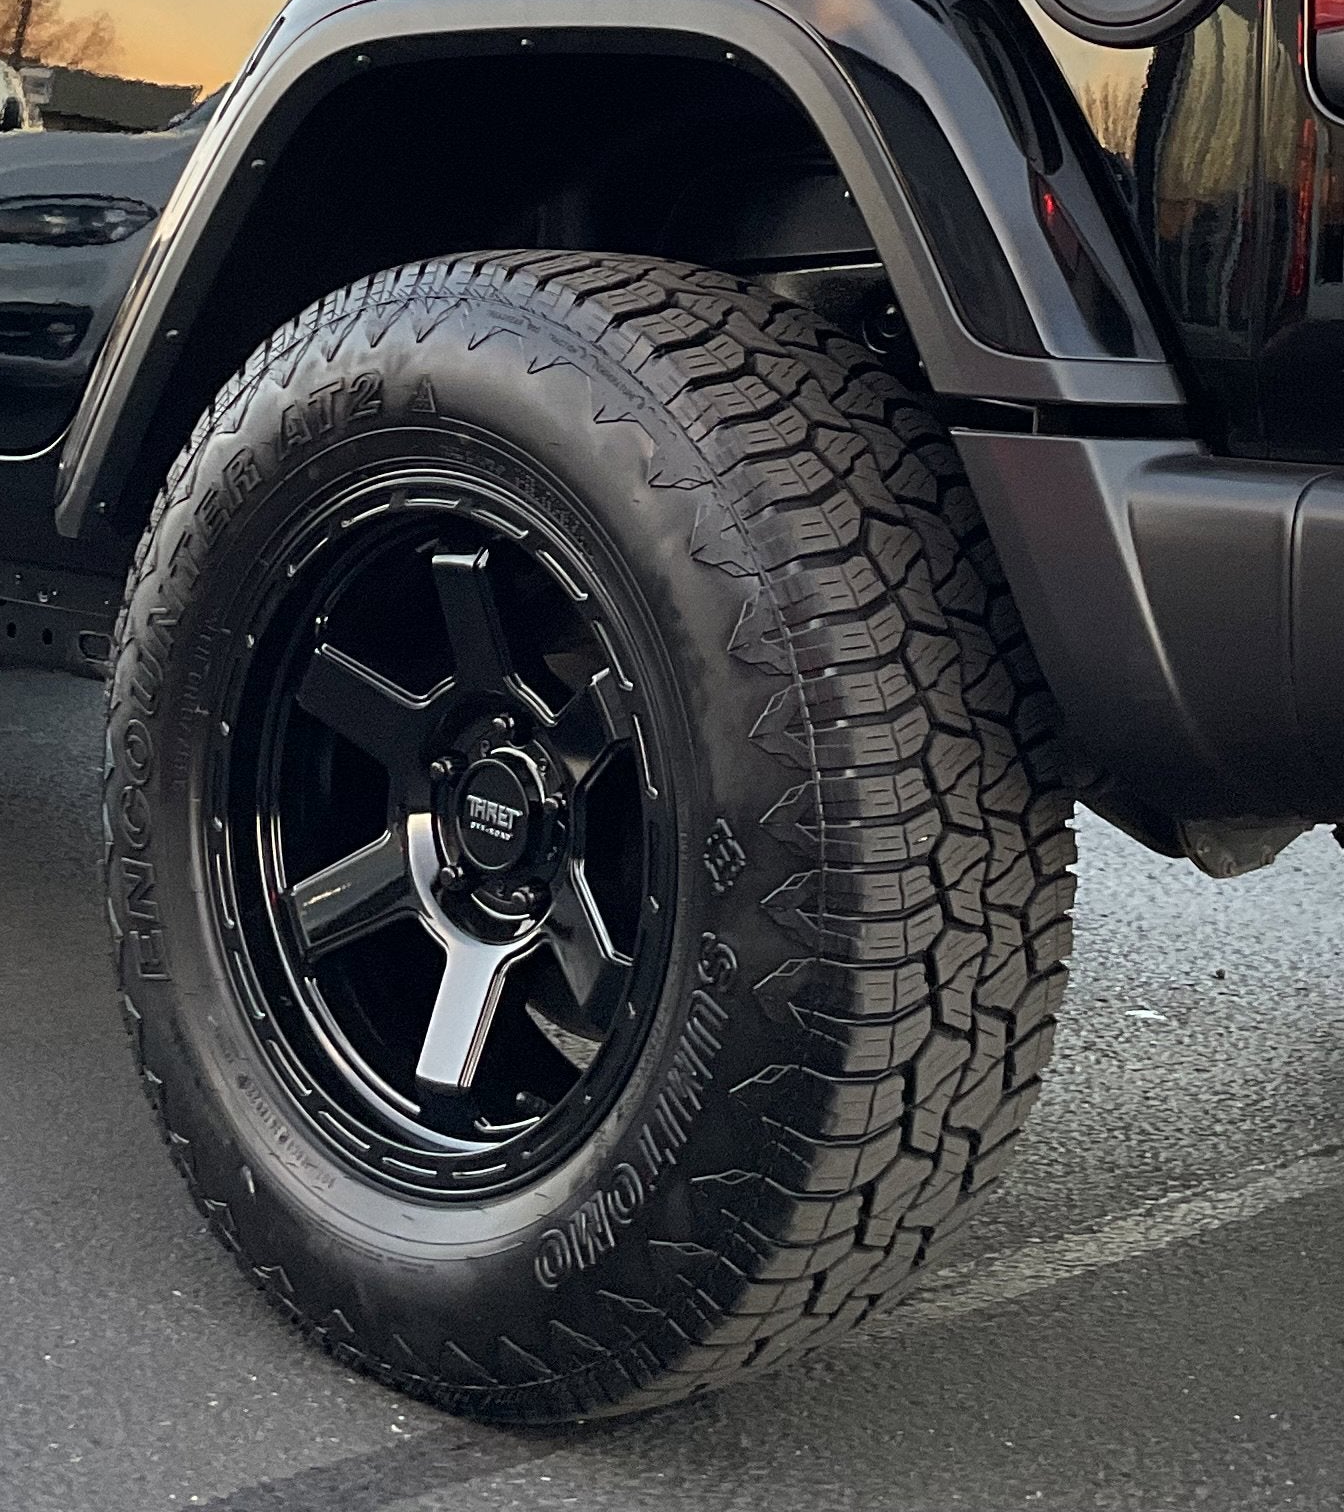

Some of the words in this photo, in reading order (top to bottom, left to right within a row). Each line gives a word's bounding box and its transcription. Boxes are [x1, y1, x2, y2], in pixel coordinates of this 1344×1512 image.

[119, 444, 263, 982] ENCOUNTER
[275, 366, 385, 462] AT2
[466, 794, 524, 830] THRET
[534, 929, 738, 1288] SUMITOMO
